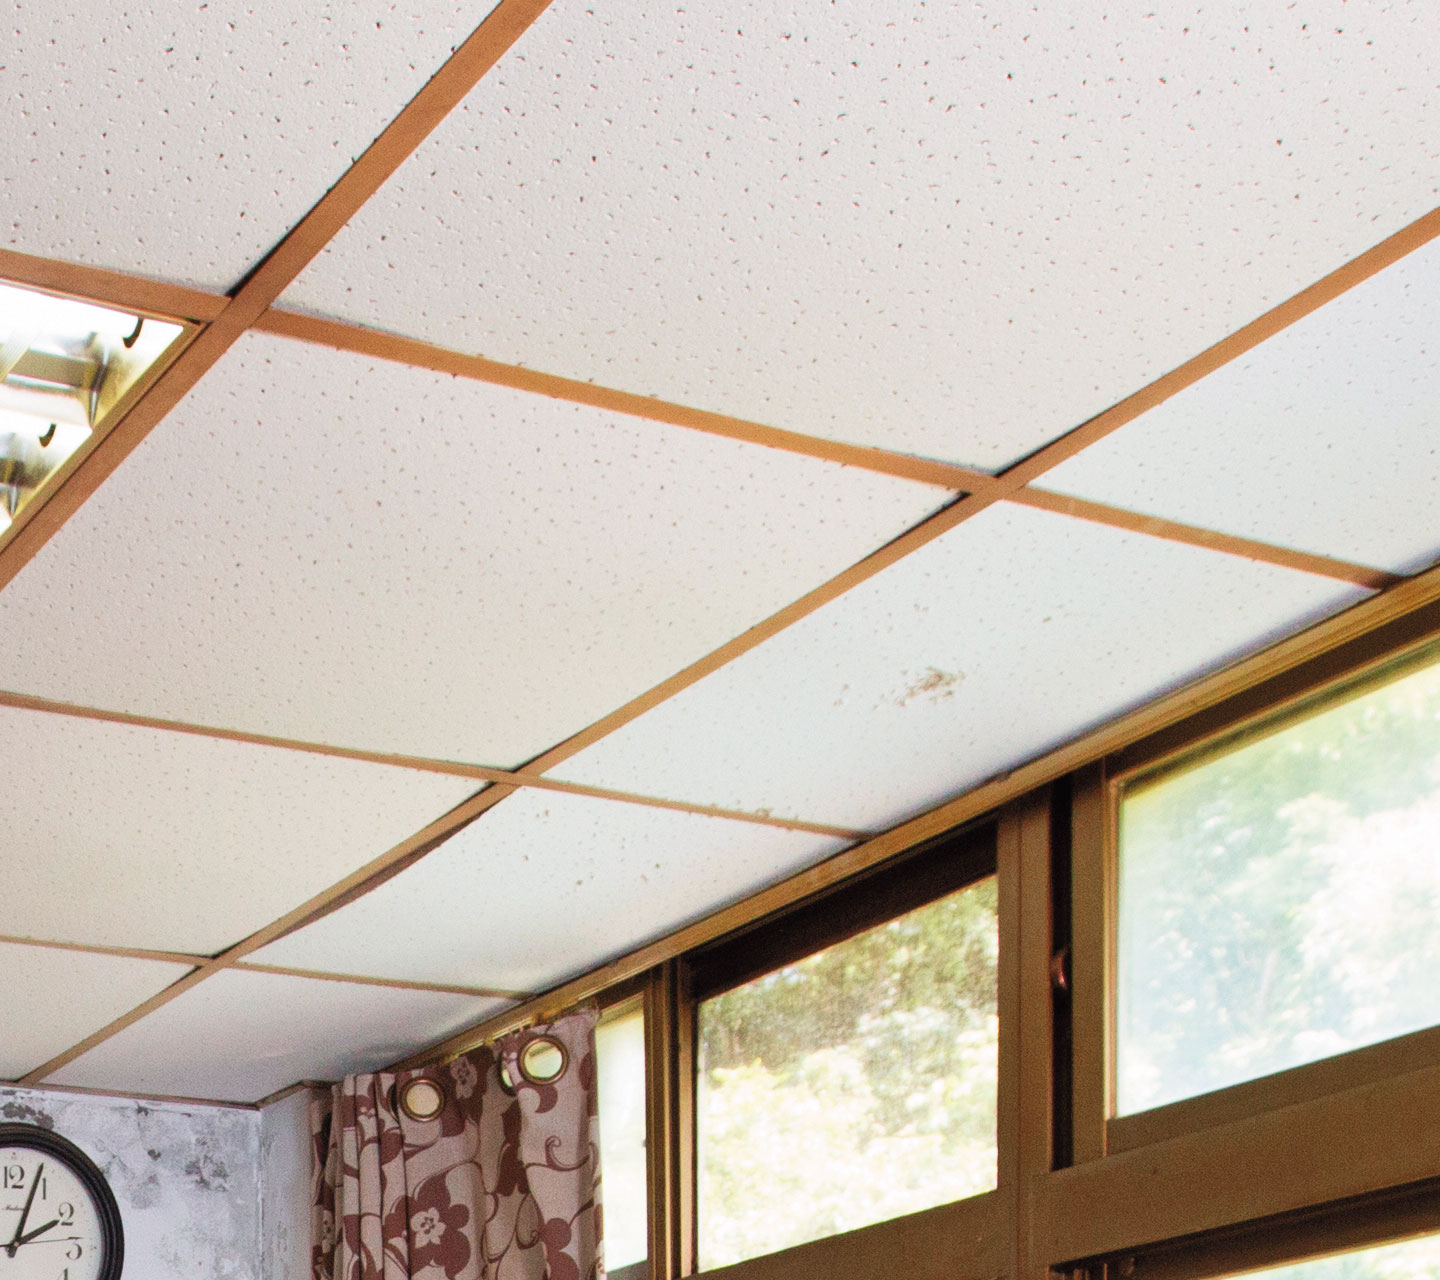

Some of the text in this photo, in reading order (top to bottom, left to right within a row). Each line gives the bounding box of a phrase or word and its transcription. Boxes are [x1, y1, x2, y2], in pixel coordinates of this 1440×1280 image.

[3, 1165, 25, 1190] 12
[40, 1176, 48, 1200] 1
[57, 1201, 74, 1226] 2
[65, 1236, 83, 1261] 3
